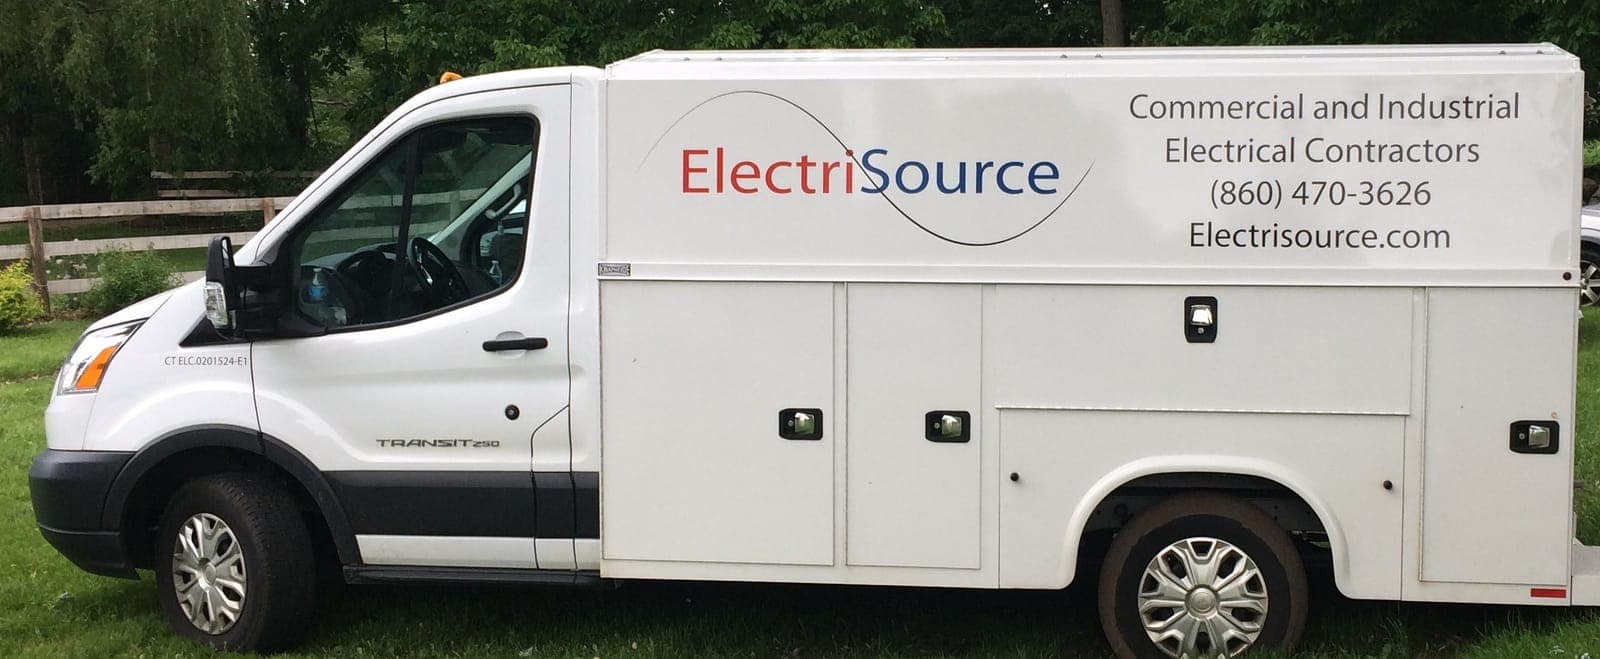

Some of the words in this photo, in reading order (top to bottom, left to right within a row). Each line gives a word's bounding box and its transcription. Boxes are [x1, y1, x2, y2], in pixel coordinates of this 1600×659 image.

[1129, 93, 1303, 120] Commercial
[1313, 92, 1369, 120] and
[1379, 92, 1520, 120] Industrial
[1166, 136, 1295, 163] Electrical
[1305, 137, 1480, 163] Contractors
[681, 147, 1060, 195] ElectriSource
[1210, 179, 1283, 210] (860)
[1291, 180, 1432, 207] 470-3626
[1190, 222, 1451, 249] Electrisource.com
[164, 356, 177, 366] CT
[178, 356, 248, 367] ELC.0201524-E1
[376, 438, 472, 448] TRANSIT
[472, 440, 500, 448] 250
